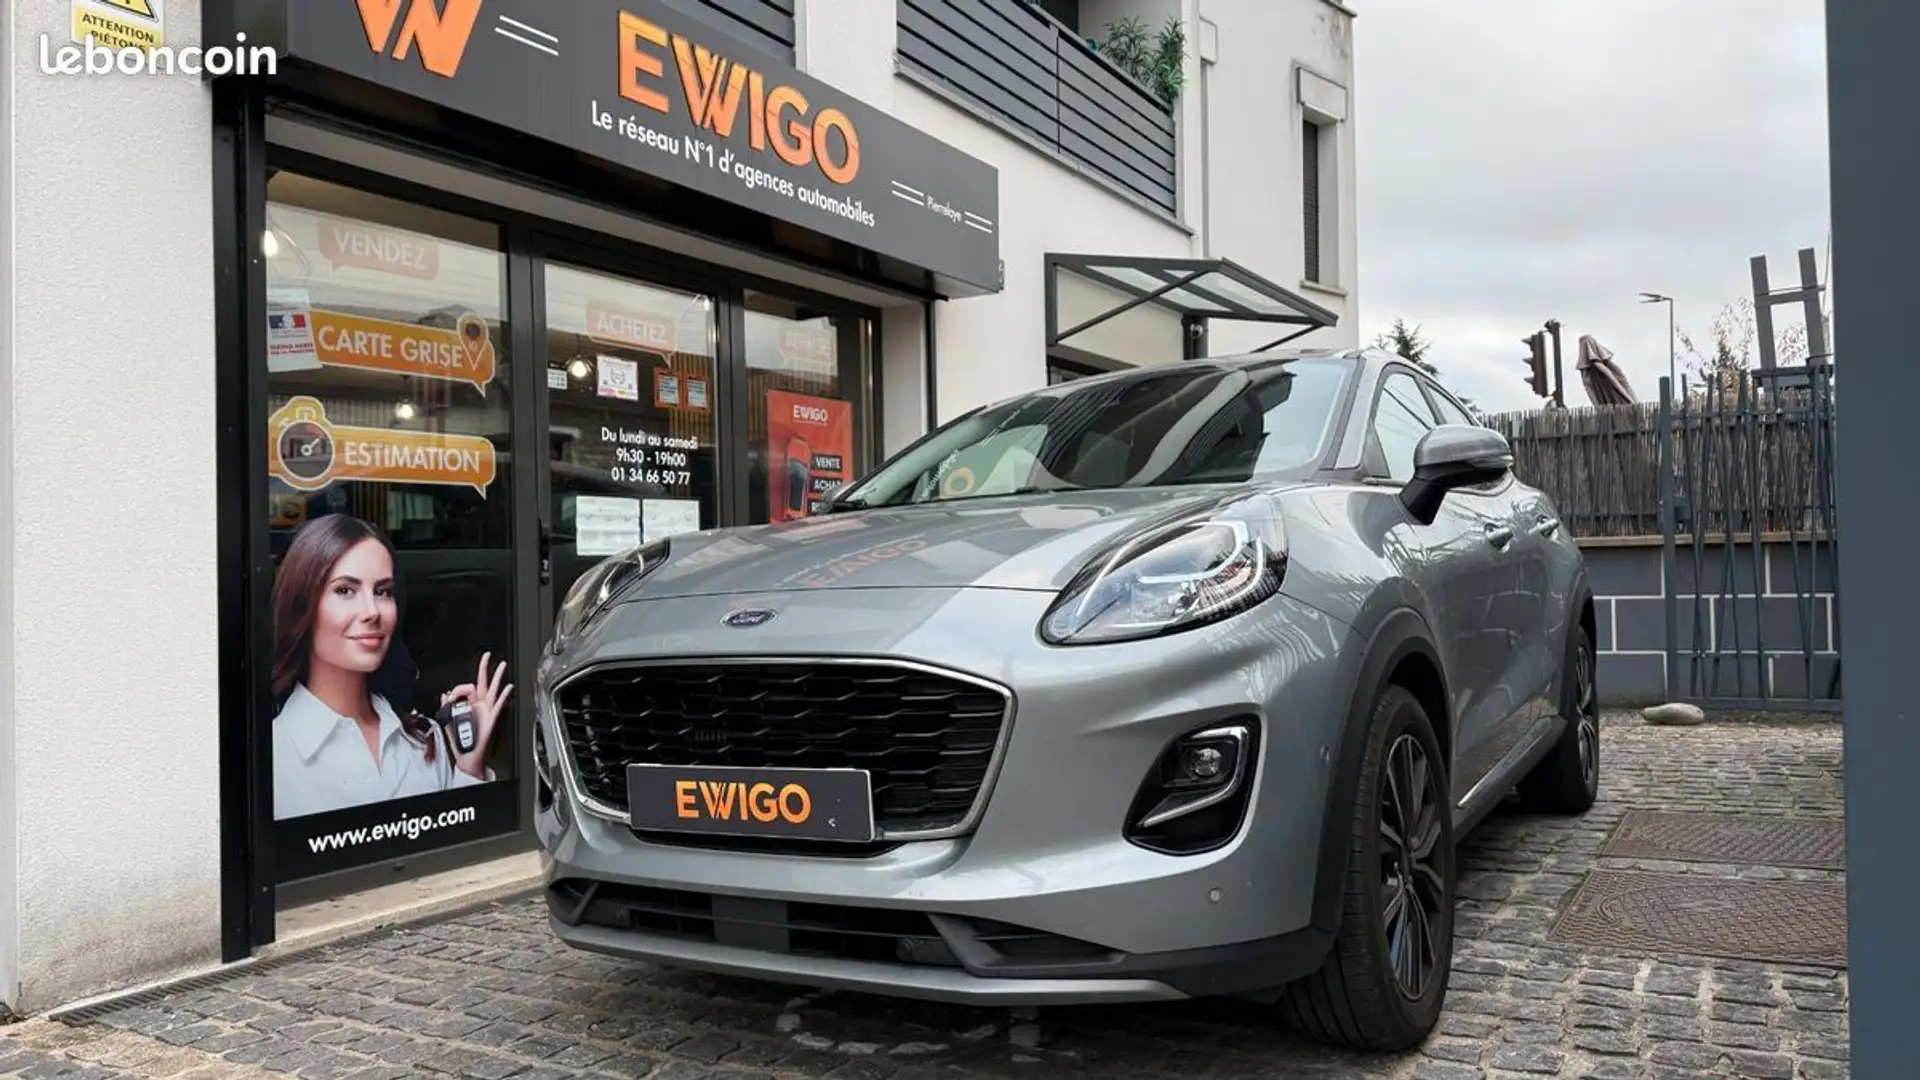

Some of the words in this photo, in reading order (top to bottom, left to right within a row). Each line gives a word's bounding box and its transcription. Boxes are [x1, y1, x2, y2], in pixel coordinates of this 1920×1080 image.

[81, 12, 154, 43] ATTENTION
[618, 9, 860, 184] EWIGO
[591, 100, 613, 130] Le
[618, 115, 679, 155] réseau
[684, 135, 714, 168] N°1
[718, 148, 794, 198] d'agences
[798, 185, 875, 227] automobiles
[332, 227, 428, 270] VENDEZ
[597, 312, 668, 343] ACHETEZ
[318, 324, 392, 359] CARTE
[400, 338, 463, 368] GRISE
[793, 404, 829, 422] EWIGO
[601, 427, 617, 442] Du
[619, 427, 646, 445] lundi
[647, 435, 662, 446] au
[663, 434, 698, 449] samedi
[343, 440, 480, 473] ESTIMATION
[615, 447, 645, 464] 9h30
[654, 451, 687, 467] 19h00
[814, 456, 841, 469] VENTE
[611, 466, 625, 482] 01
[628, 468, 643, 482] 34
[646, 469, 660, 483] 66
[662, 470, 676, 485] 50
[678, 471, 691, 485] 77
[675, 780, 811, 824] EWIGO
[308, 806, 475, 854] www.ewigo.com
